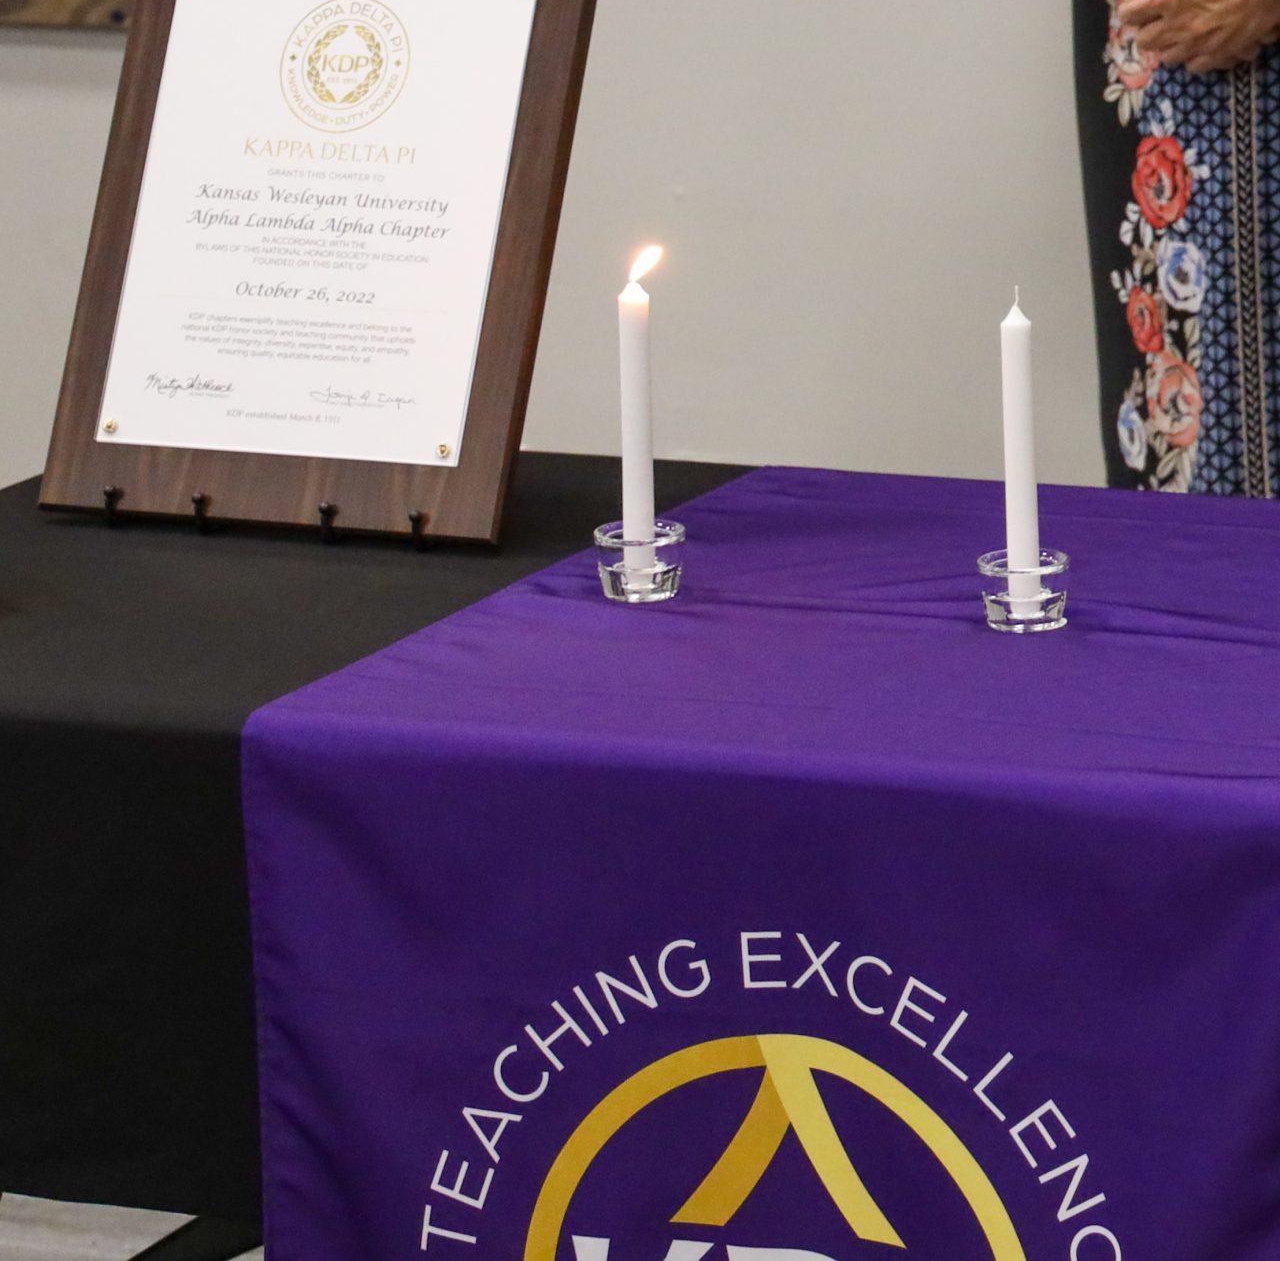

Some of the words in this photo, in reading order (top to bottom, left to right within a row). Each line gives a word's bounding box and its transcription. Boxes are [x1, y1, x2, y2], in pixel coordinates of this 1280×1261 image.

[294, 4, 346, 48] KAPPA
[350, 2, 394, 34] DELTA
[390, 35, 404, 53] PI
[322, 54, 370, 73] KDP
[287, 68, 329, 124] KNOWLEDGE
[335, 112, 364, 125] DUTY
[369, 74, 399, 112] POWER
[243, 137, 314, 159] KAPPA
[320, 141, 391, 164] DELTA
[396, 146, 416, 165] PI
[267, 168, 304, 179] GRANTS
[307, 170, 326, 180] THIS
[328, 171, 370, 182] CHARTER
[372, 173, 385, 183] TO
[195, 183, 260, 202] Kansas
[267, 185, 348, 211] Wesleyan
[354, 193, 449, 218] University
[186, 209, 240, 231] Alpha
[244, 212, 315, 231] Lambda
[320, 216, 374, 239] Alpha
[379, 219, 451, 243] Chapter
[271, 237, 327, 247] ACCORDANCE
[329, 239, 349, 248] WITH
[351, 241, 367, 249] THE
[252, 256, 295, 268] FOUNDED
[297, 259, 310, 268] ON
[312, 260, 331, 269] THIS
[332, 261, 353, 270] DATE
[356, 262, 368, 271] OF
[235, 281, 301, 299] October
[306, 286, 330, 303] 26,
[336, 290, 376, 304] 2022
[421, 939, 711, 1251] TEACHING
